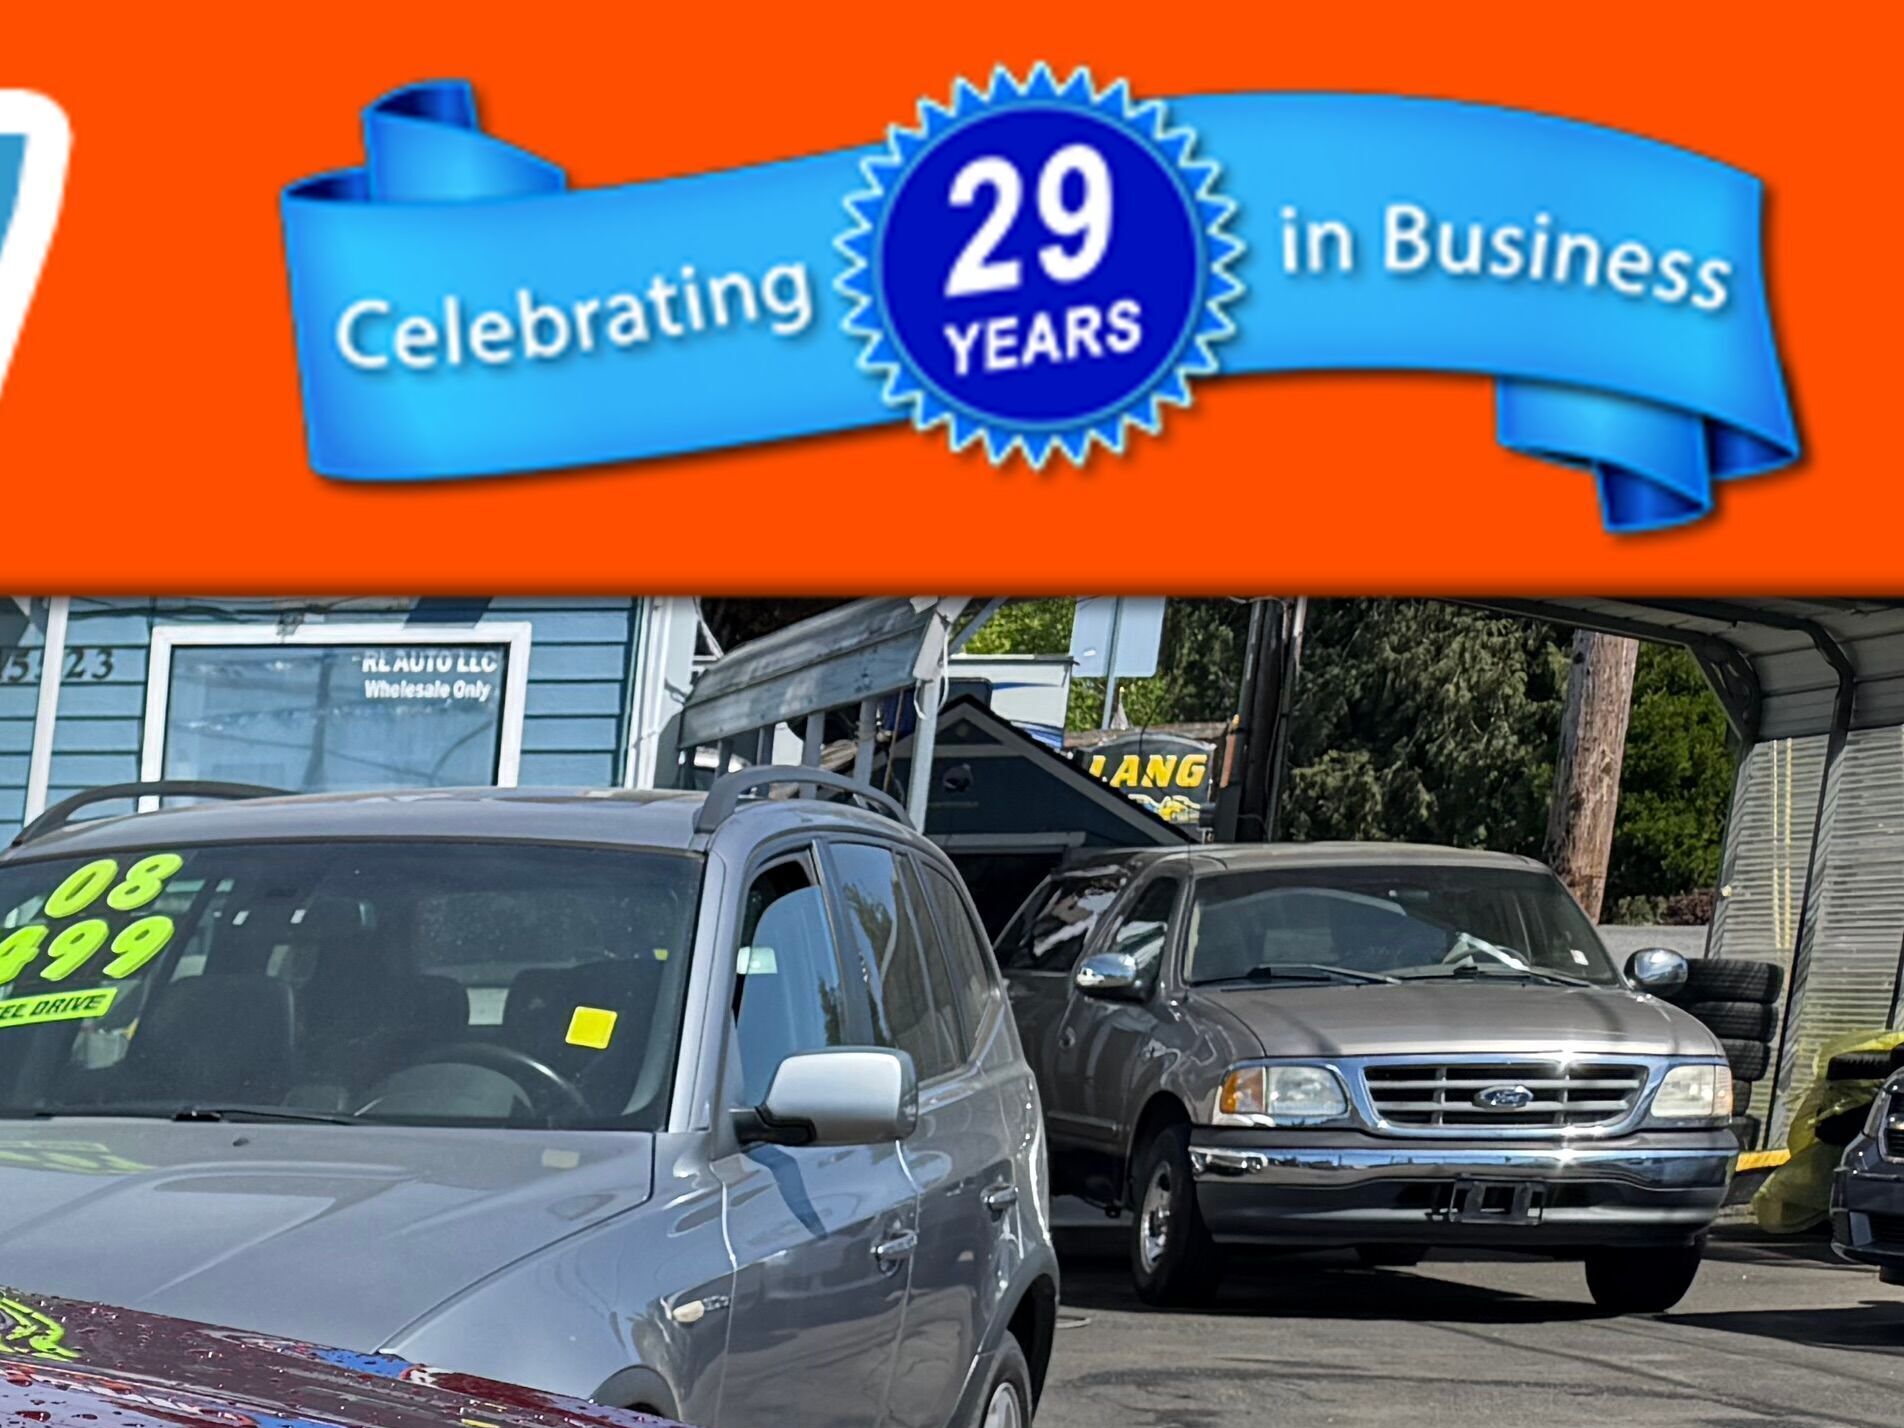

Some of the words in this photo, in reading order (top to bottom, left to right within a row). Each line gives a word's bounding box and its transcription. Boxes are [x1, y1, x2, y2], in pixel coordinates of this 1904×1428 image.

[393, 651, 453, 673] AUTO
[456, 651, 498, 673] LLC
[364, 680, 450, 698] Wholesale
[453, 680, 491, 702] Only
[44, 853, 183, 918] 08
[29, 993, 107, 1016] DRIVE
